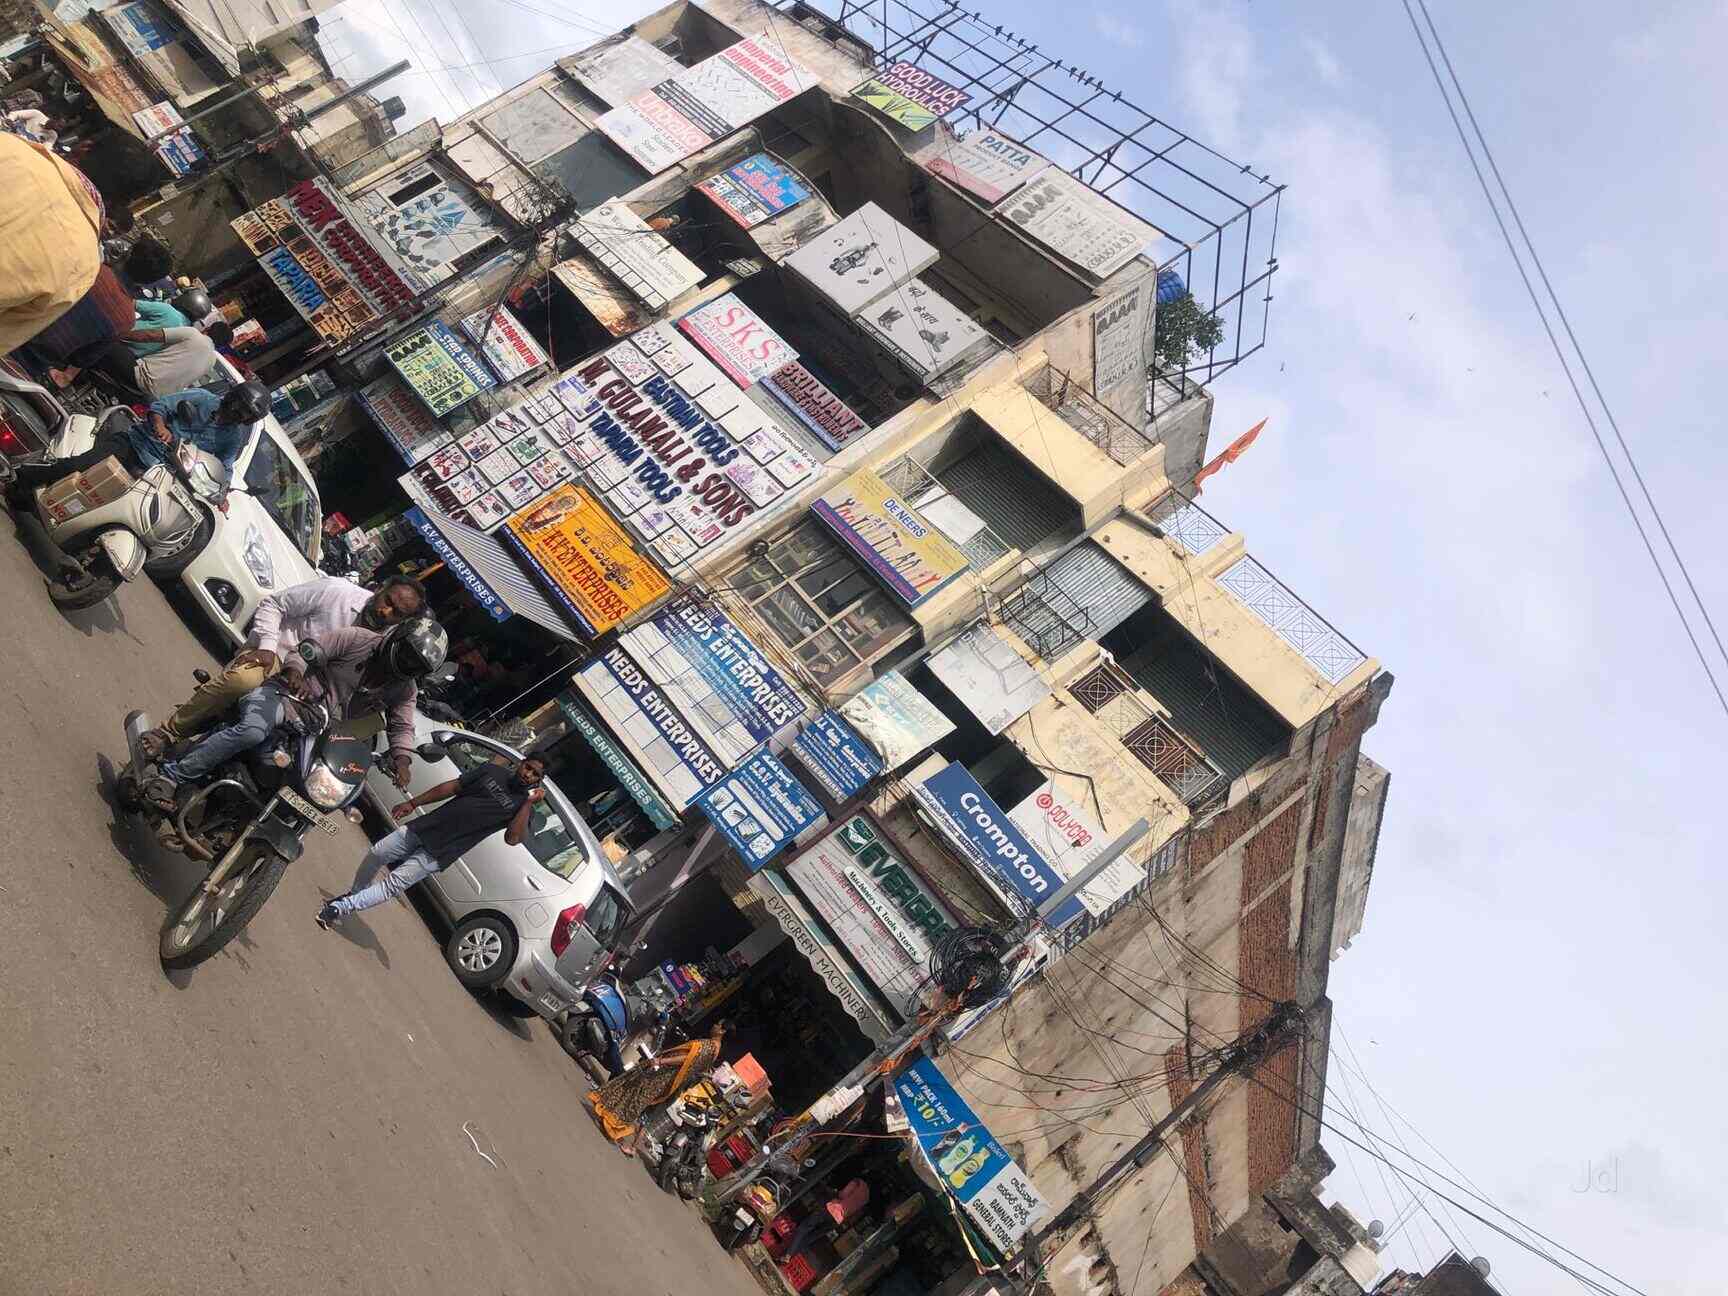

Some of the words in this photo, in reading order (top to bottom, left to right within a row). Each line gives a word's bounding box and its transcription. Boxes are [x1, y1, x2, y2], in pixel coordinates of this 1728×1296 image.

[889, 59, 935, 89] GOOD
[921, 79, 967, 106] LUCK
[979, 133, 1031, 166] PATTA
[267, 244, 328, 315] TAPARIA
[439, 333, 460, 356] STAR
[456, 351, 492, 387] SPRINGS
[712, 301, 783, 363] SKS
[640, 374, 704, 434] EASTMAN
[690, 421, 740, 469] TOOLS
[778, 360, 864, 435] BRILLIANT
[586, 409, 645, 467] TAPARIA
[630, 455, 683, 507] TOOLS
[594, 377, 693, 470] GULAMALI
[673, 452, 708, 487] &
[691, 469, 755, 530] SONS
[883, 498, 901, 513] DE
[896, 510, 927, 538] NEERS
[419, 521, 441, 541] K.V.
[434, 538, 496, 605] ENTERPRISES
[555, 544, 630, 622] ENTERPRISES
[603, 646, 650, 695] NEEDS
[639, 691, 723, 786] ENTERPRISES
[708, 635, 794, 726] ENTERPRISES
[565, 702, 595, 737] NEEDS
[590, 734, 653, 806] ENTERPRISES
[956, 789, 1050, 894] Crompton
[846, 870, 877, 906] Machinery
[874, 904, 883, 912] &
[880, 911, 898, 931] Tools
[896, 930, 918, 956] Stores
[766, 895, 818, 957] EVERGREEN
[814, 958, 870, 1023] MACHINERY
[907, 1069, 924, 1086] NEW
[920, 1084, 937, 1102] PACK
[971, 1197, 997, 1227] GENERAL
[991, 1223, 1013, 1248] STORES
[988, 1198, 1016, 1230] RAMNATH
